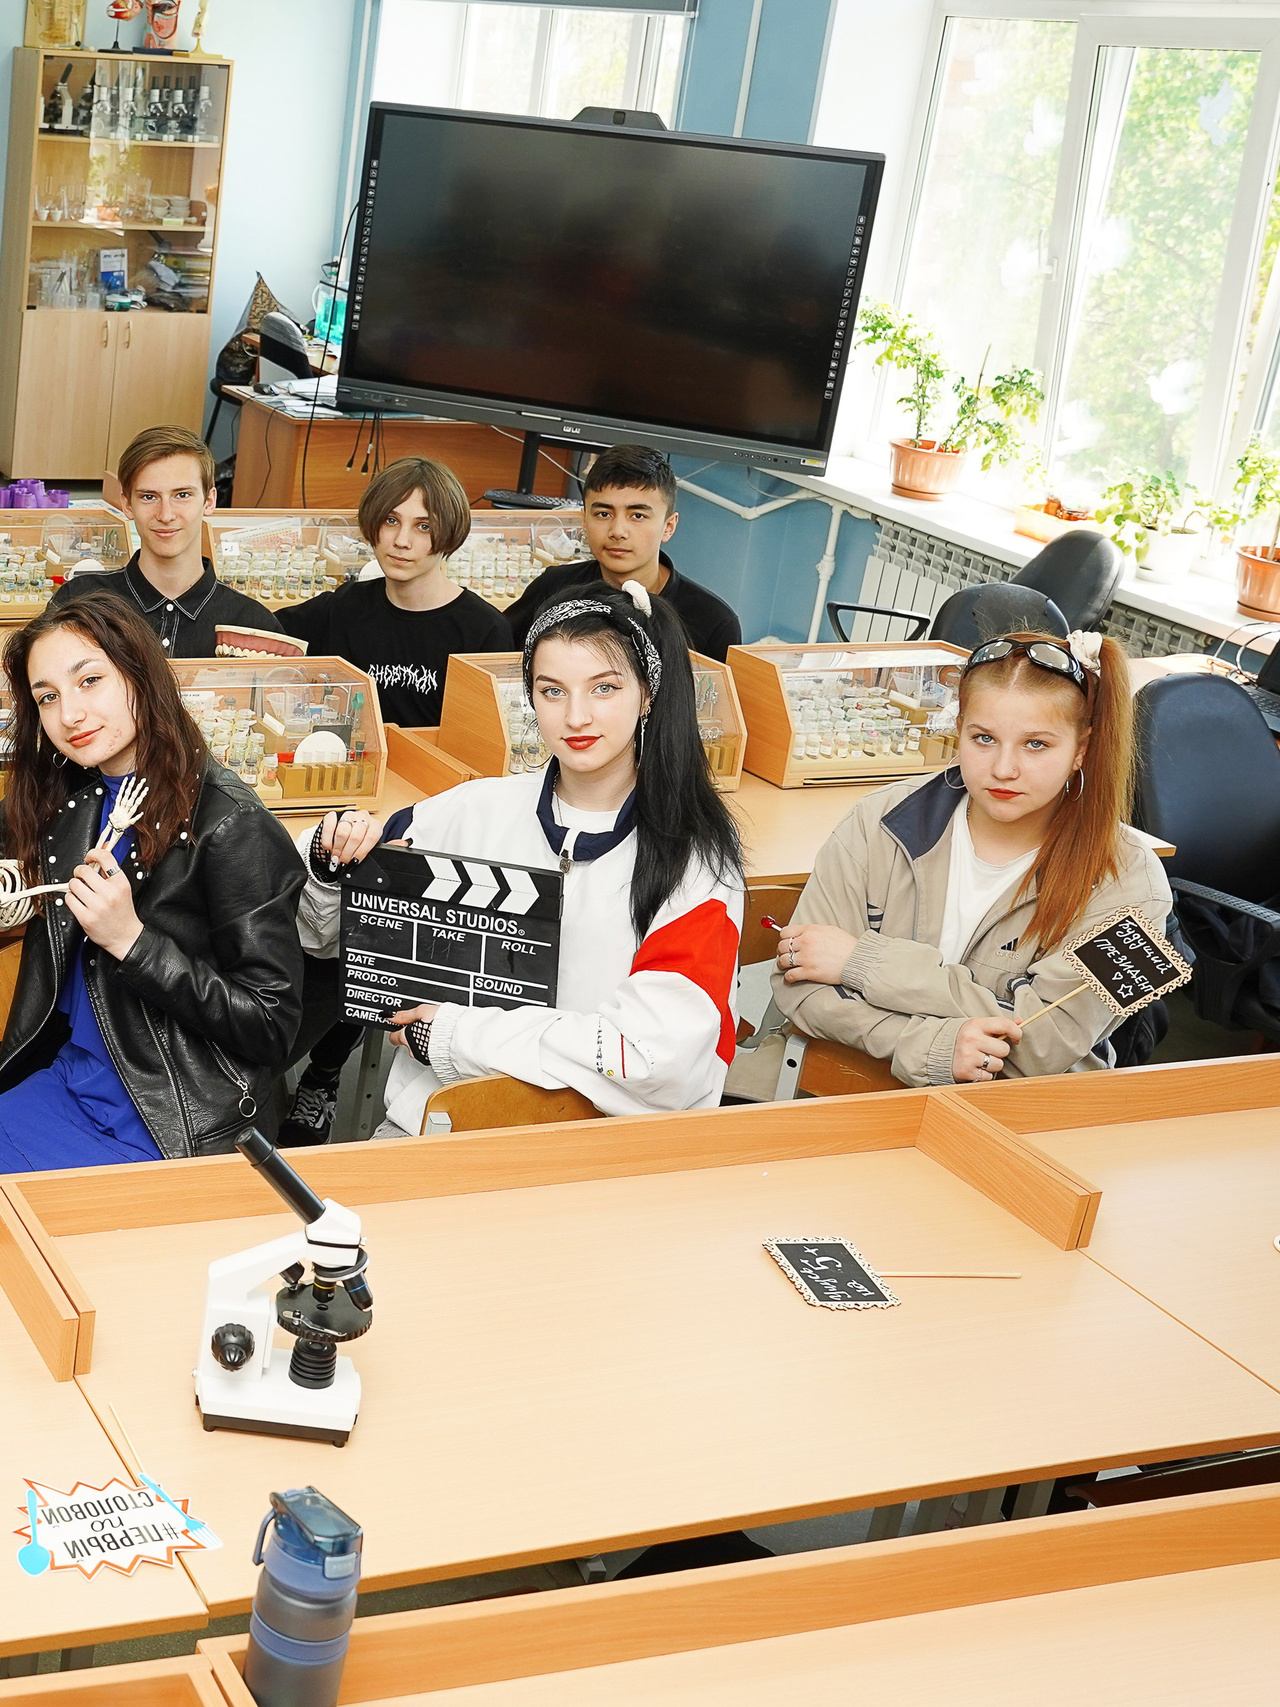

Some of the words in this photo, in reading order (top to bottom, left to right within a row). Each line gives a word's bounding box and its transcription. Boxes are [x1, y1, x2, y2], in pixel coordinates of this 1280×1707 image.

[351, 891, 441, 922] UNIVERSAL
[359, 914, 404, 931] SCENE
[431, 927, 466, 943] TAKE
[500, 939, 537, 956] ROLL
[346, 953, 376, 966] DATE
[1093, 938, 1155, 992] ПРЕЗИДЕНТ
[346, 969, 399, 987] PROD.CO.
[474, 977, 523, 995] SOUND
[346, 988, 402, 1008] DIRECTOR
[40, 1491, 155, 1529] СТОЛОВОЙ
[90, 1516, 125, 1533] по
[63, 1522, 181, 1563] #ПЕРВЫЙ
